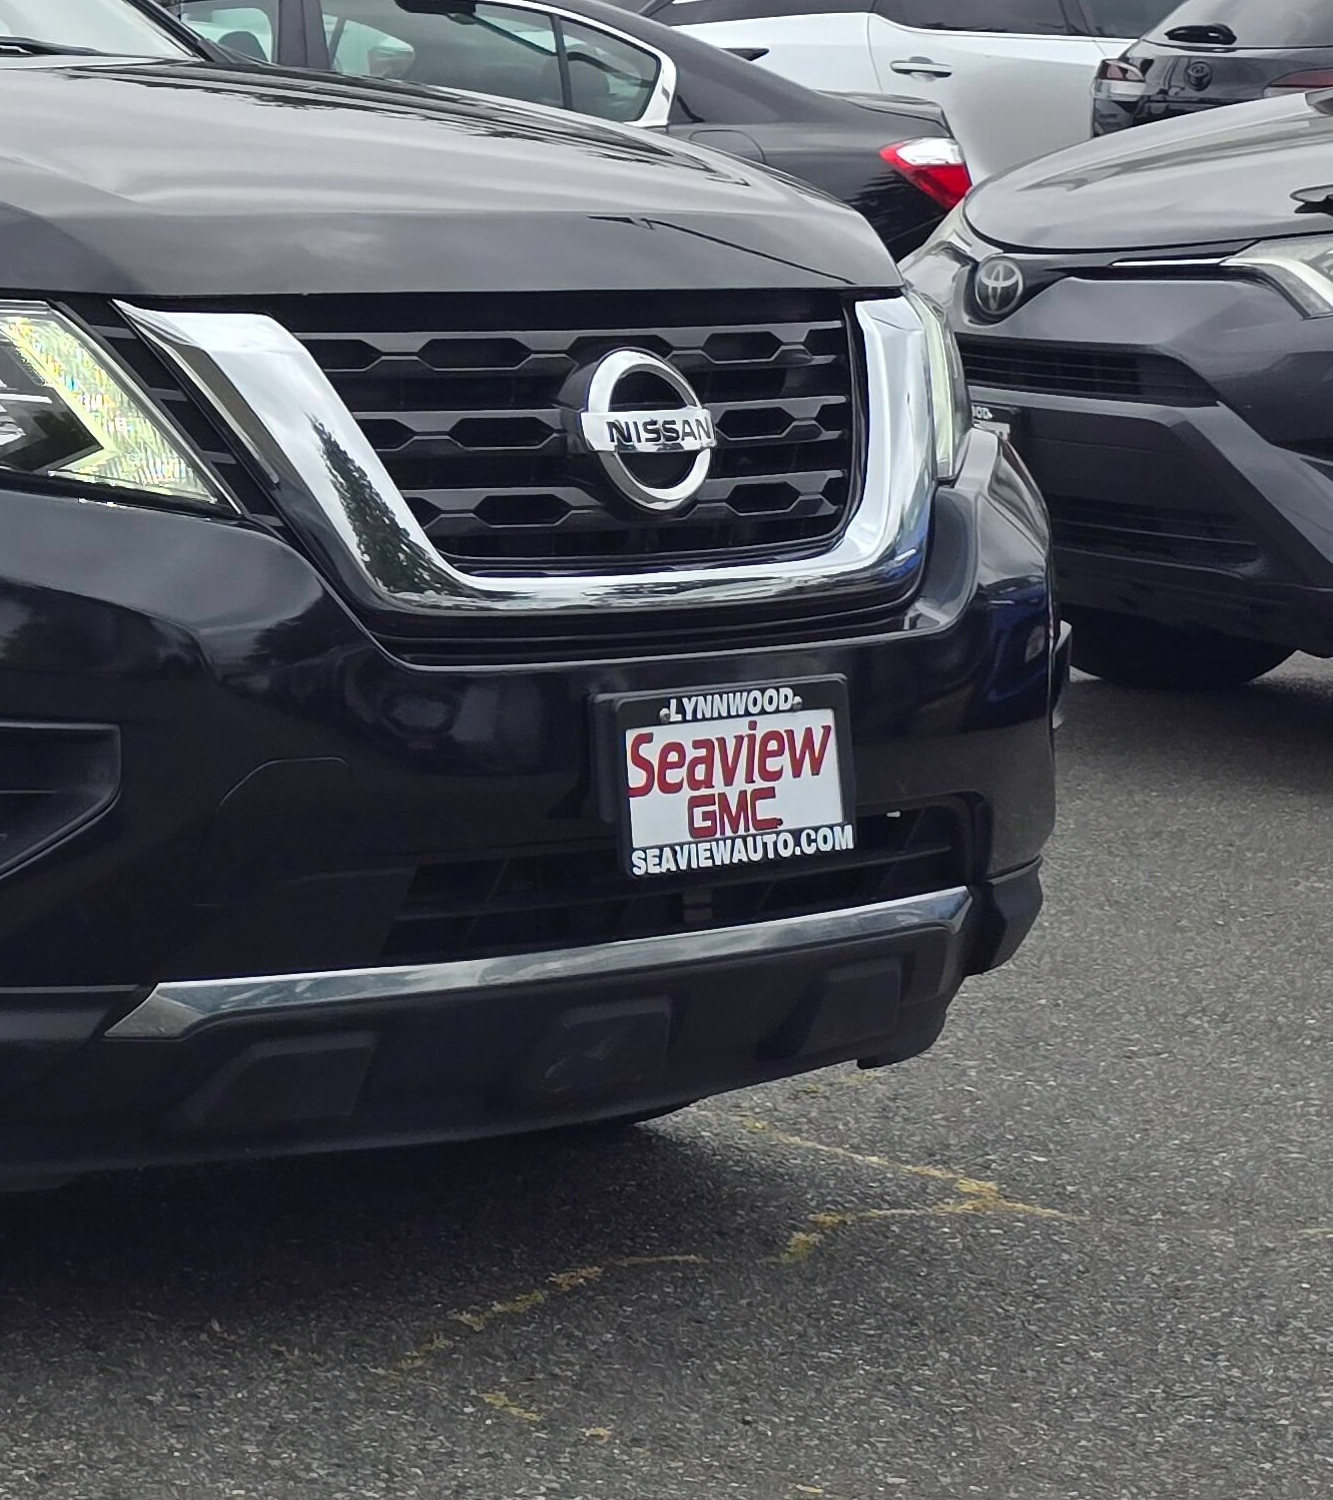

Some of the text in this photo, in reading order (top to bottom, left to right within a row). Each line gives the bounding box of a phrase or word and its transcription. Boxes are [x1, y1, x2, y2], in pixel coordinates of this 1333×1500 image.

[605, 417, 712, 444] NISSAN
[669, 687, 794, 722] LYNNWOOD
[628, 720, 832, 798] Seaview
[687, 786, 784, 840] GMC
[631, 825, 855, 876] SEAVIEWAUTO.COM
